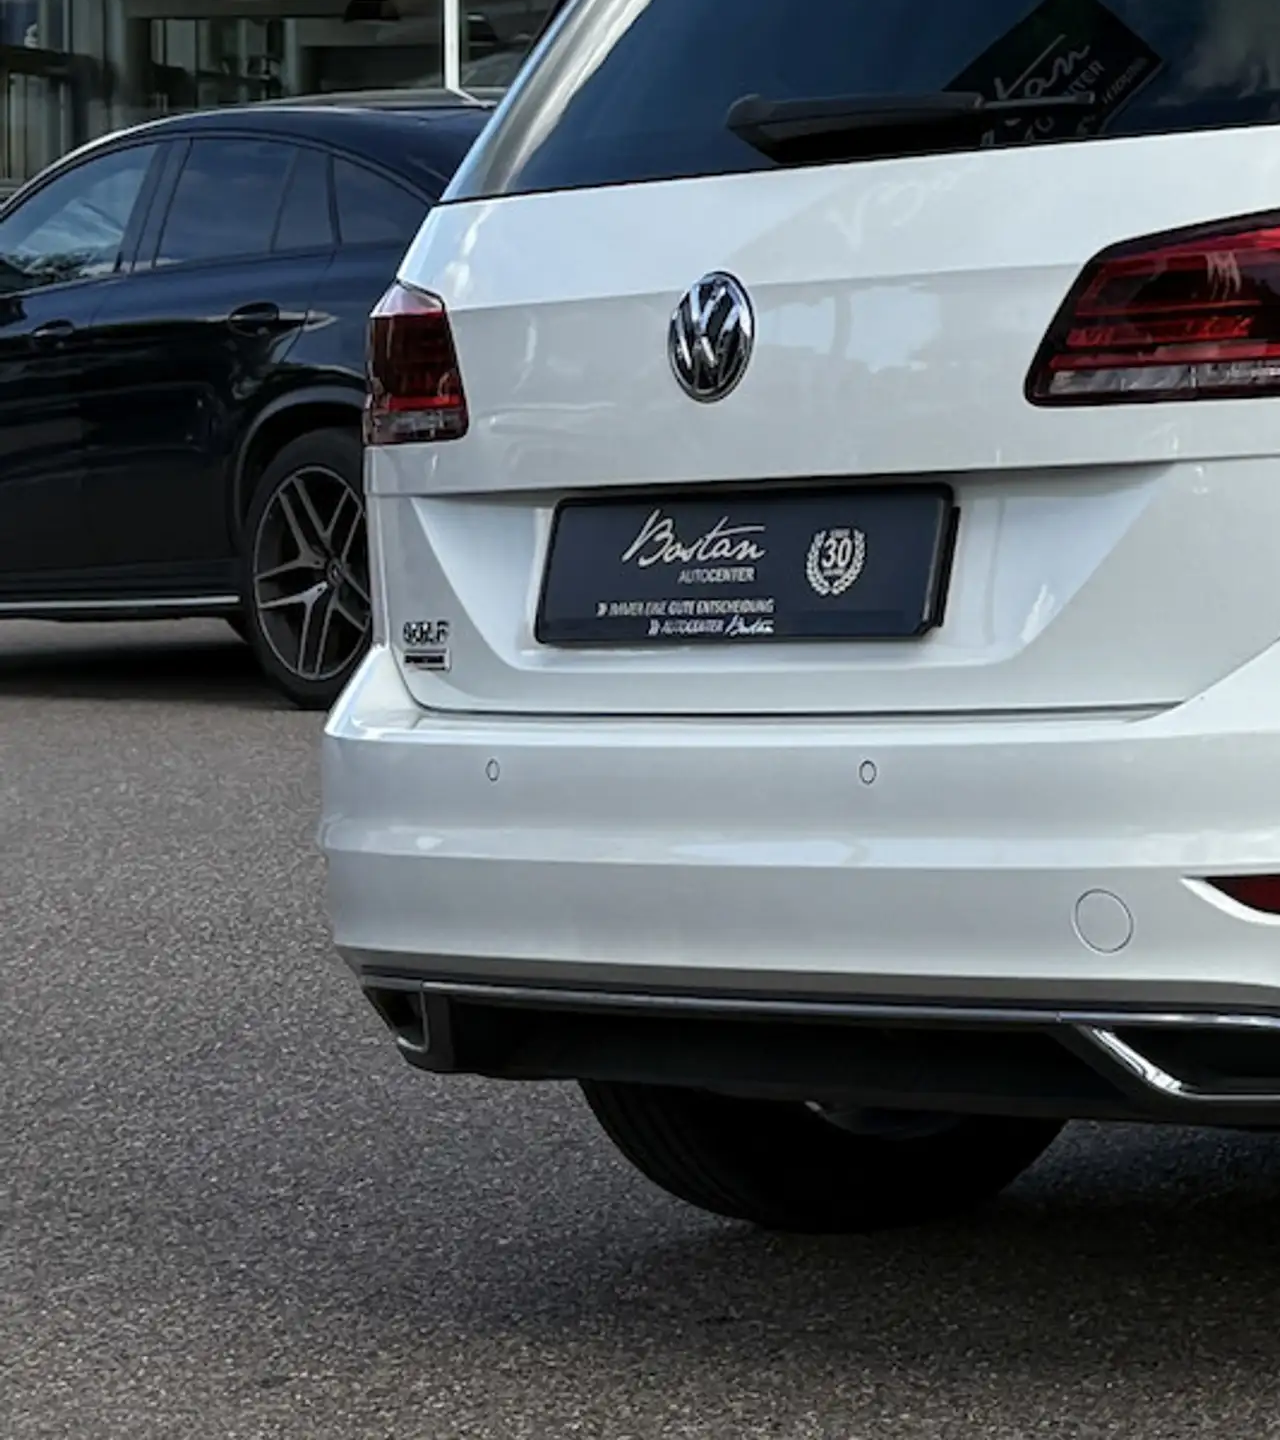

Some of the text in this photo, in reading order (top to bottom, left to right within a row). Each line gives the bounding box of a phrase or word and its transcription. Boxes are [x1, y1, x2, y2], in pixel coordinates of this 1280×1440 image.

[621, 509, 766, 567] Bostan
[821, 537, 853, 568] 30
[677, 566, 755, 584] AUTOCENTER
